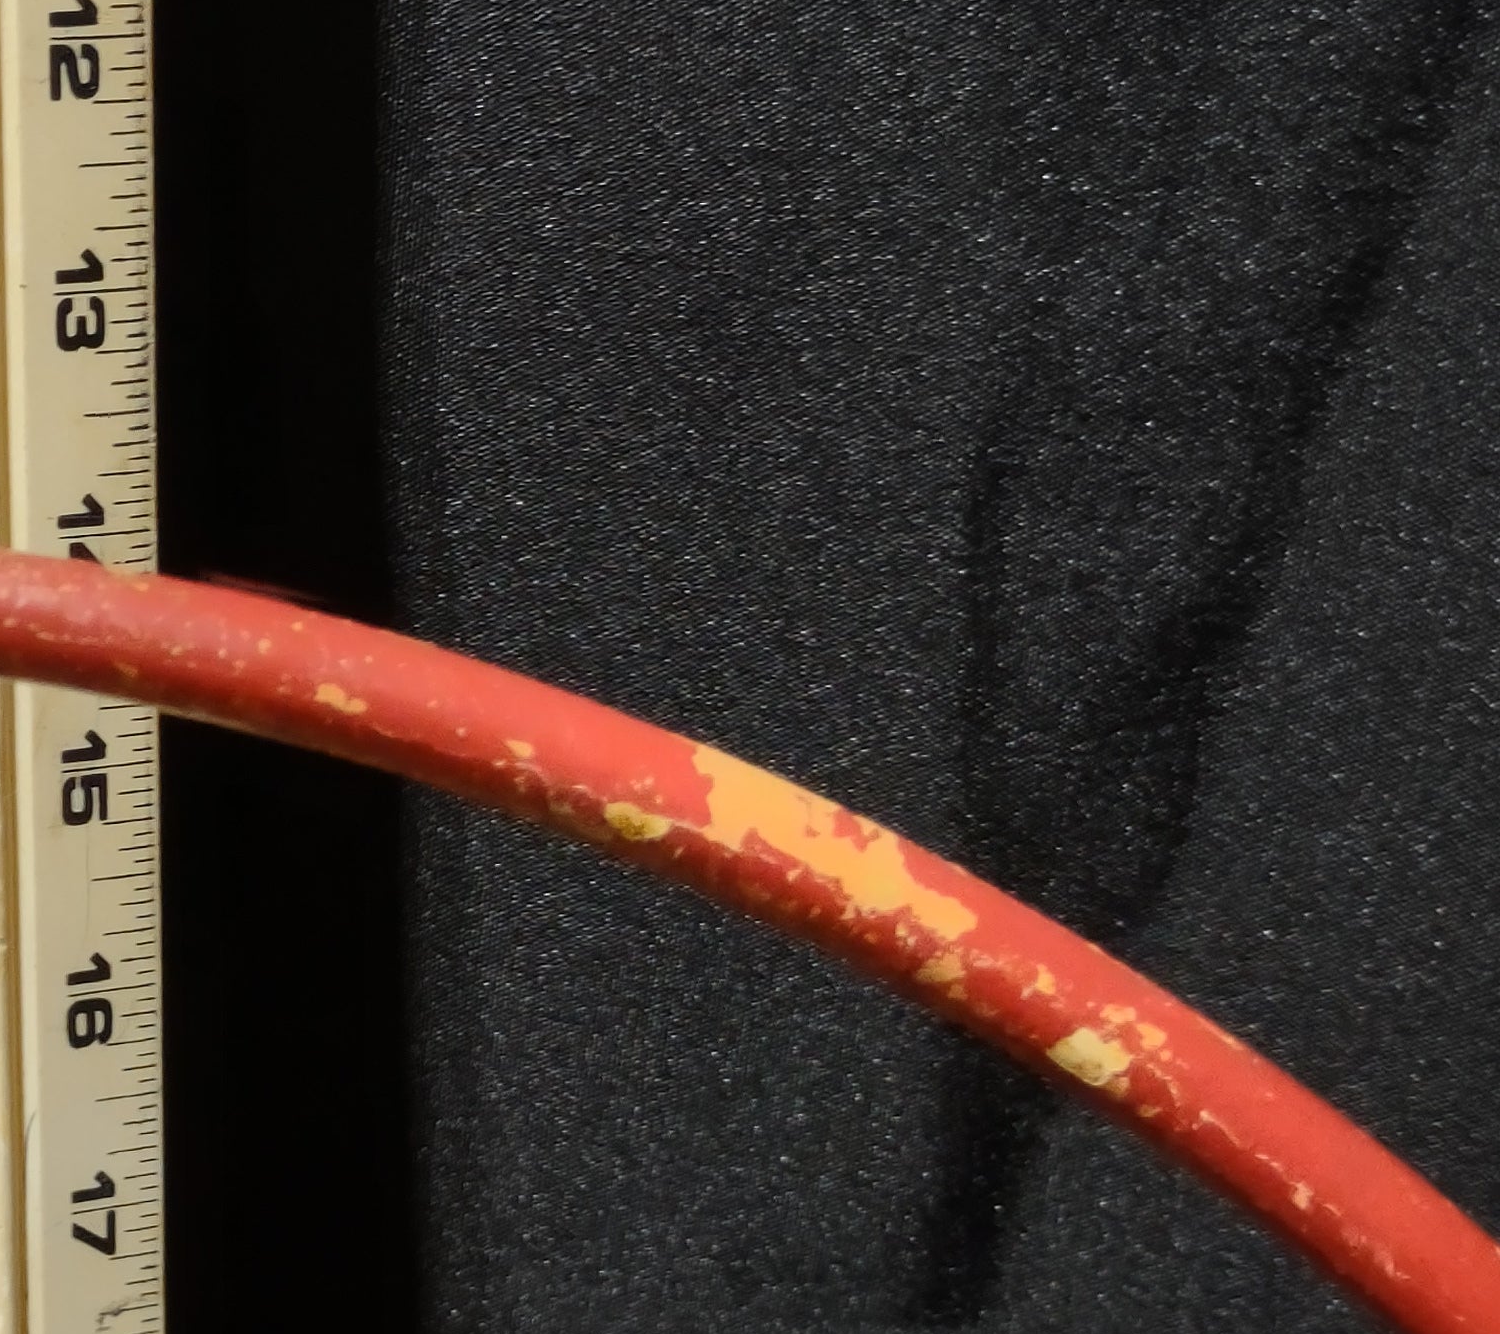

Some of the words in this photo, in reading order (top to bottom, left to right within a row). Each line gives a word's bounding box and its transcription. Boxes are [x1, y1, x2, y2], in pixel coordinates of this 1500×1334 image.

[54, 248, 104, 352] 13
[61, 730, 109, 826] 15
[71, 1171, 116, 1256] 17
